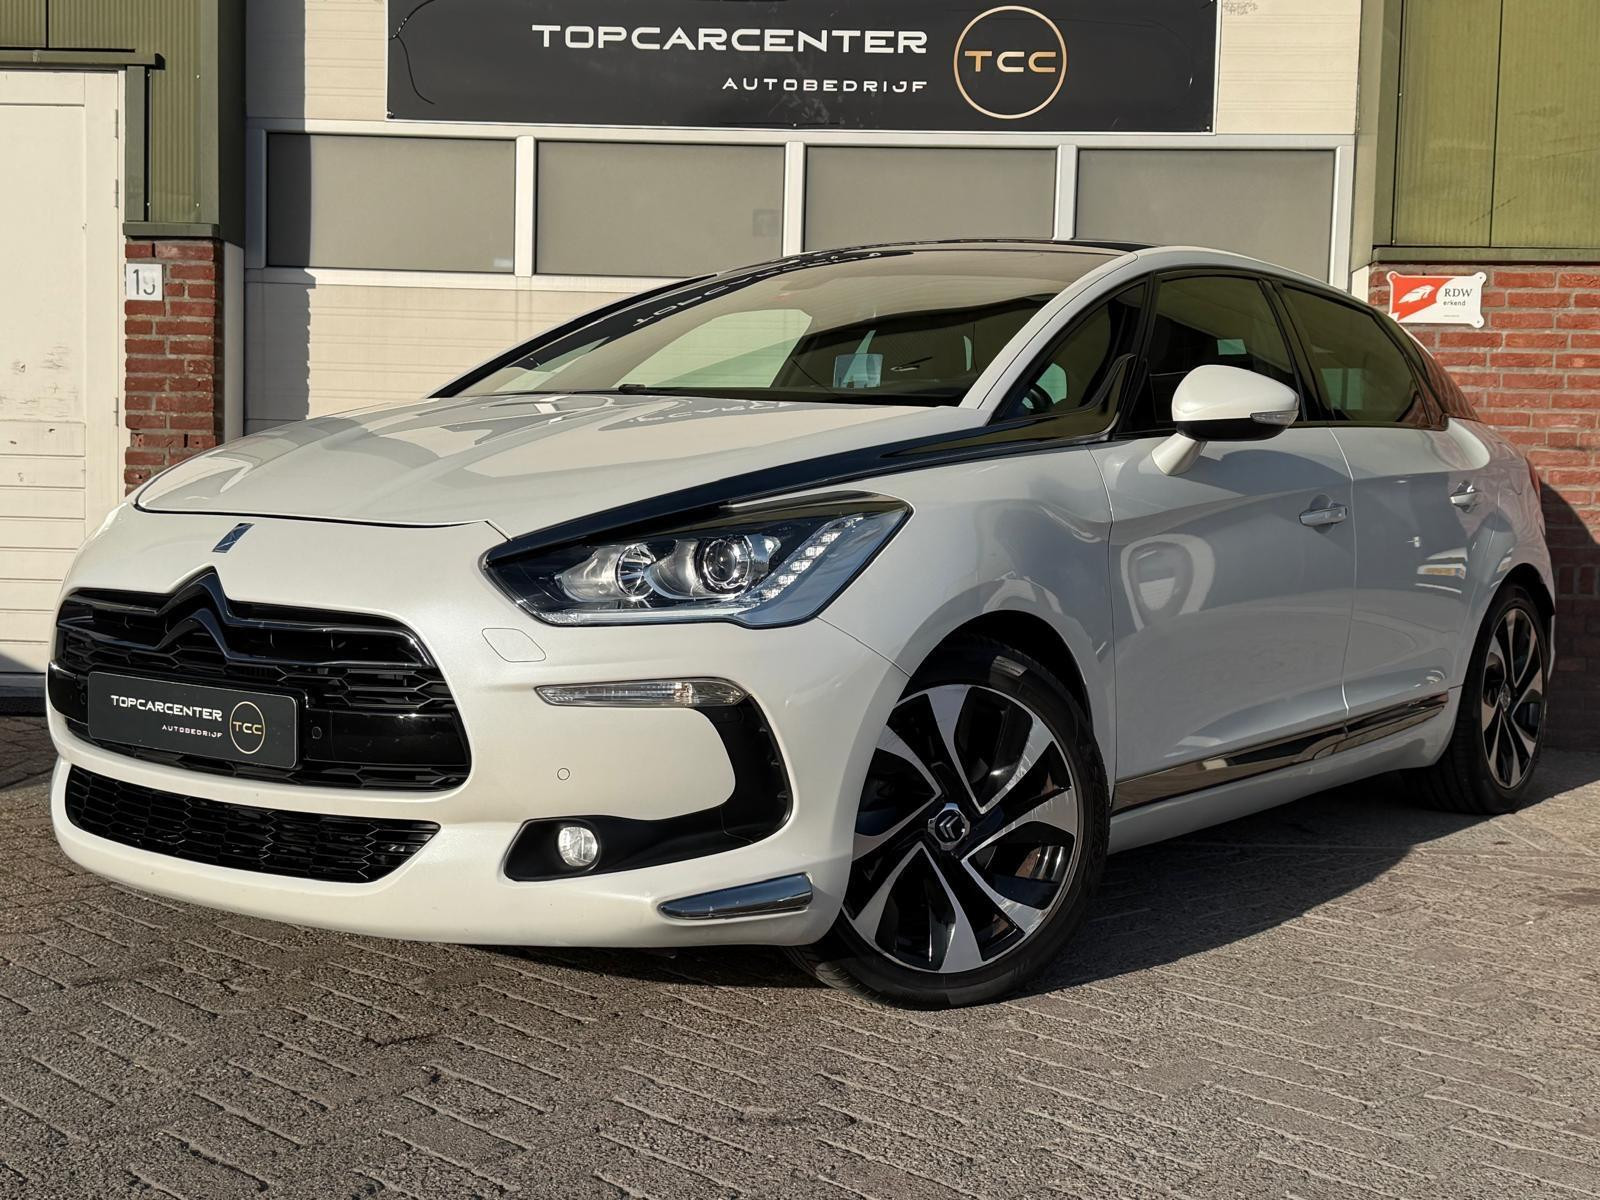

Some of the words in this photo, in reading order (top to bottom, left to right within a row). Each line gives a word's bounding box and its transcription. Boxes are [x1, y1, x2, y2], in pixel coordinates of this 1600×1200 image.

[531, 24, 928, 54] TOPCARCENTER
[964, 49, 1057, 74] TCC
[721, 77, 928, 93] AUTOBEDRIJF
[1444, 288, 1473, 297] RDW
[110, 694, 223, 722] TOPCARCENTER
[161, 724, 223, 739] AUTOBEDRIJF
[232, 721, 262, 735] TCC
